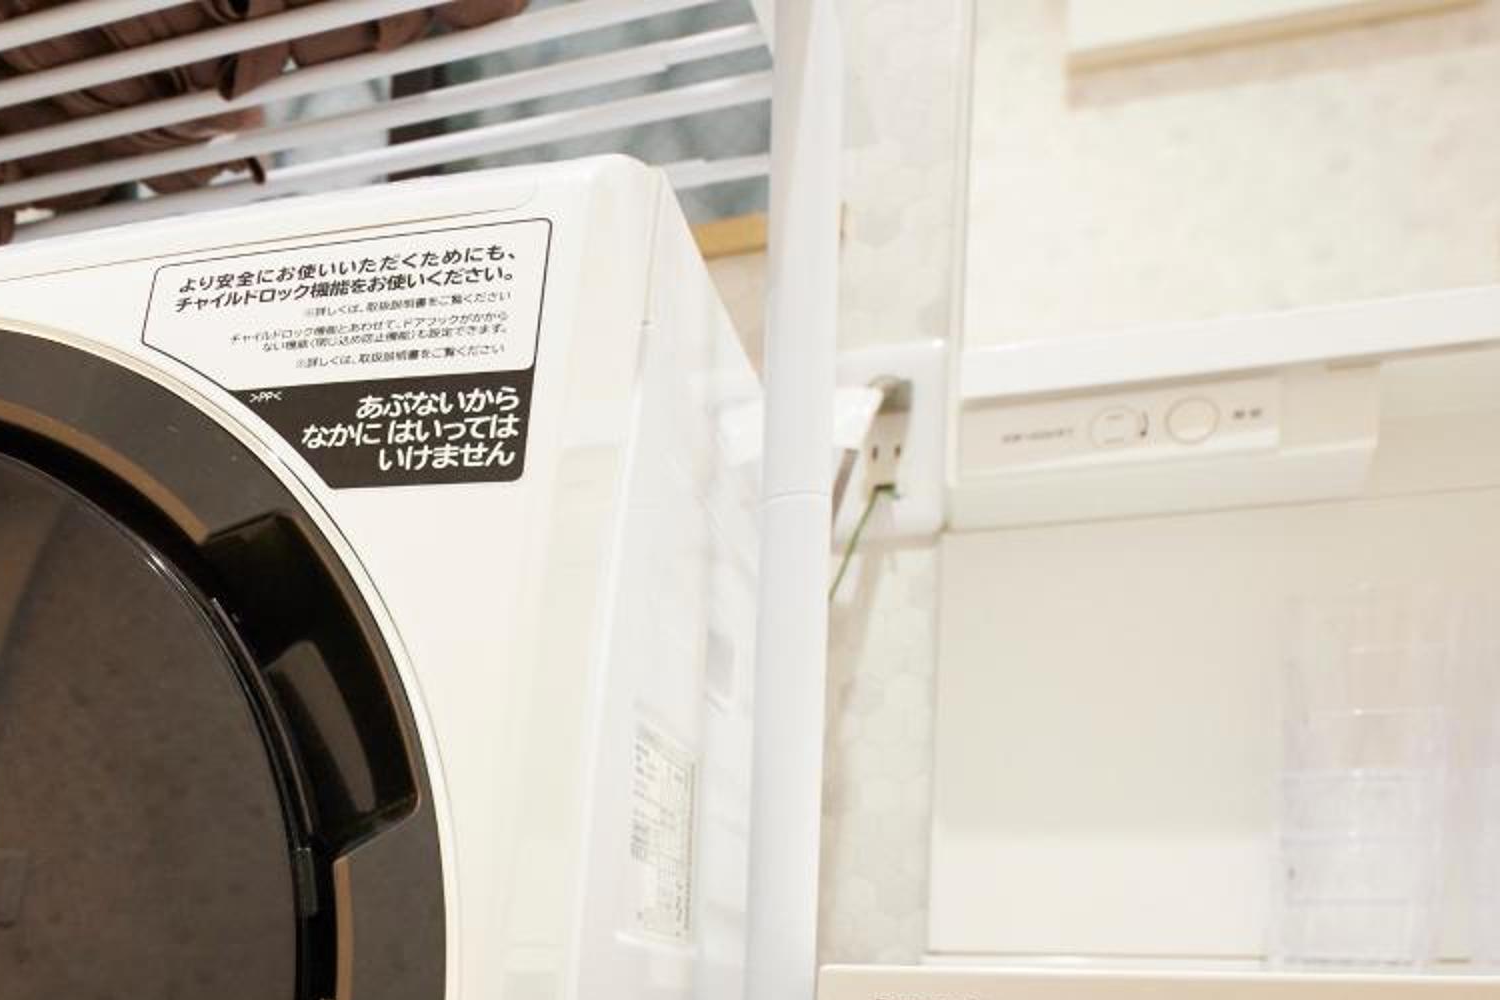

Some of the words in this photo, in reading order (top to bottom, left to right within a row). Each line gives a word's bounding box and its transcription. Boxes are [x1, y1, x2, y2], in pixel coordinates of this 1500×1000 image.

[179, 245, 515, 293] より安全にお使いいただくためにも、
[175, 267, 513, 312] チャイルドロック機能をお使いください。
[356, 386, 519, 419] あぶないから
[302, 421, 381, 449] なかに
[388, 413, 519, 444] はいっては
[378, 441, 516, 471] いけません
